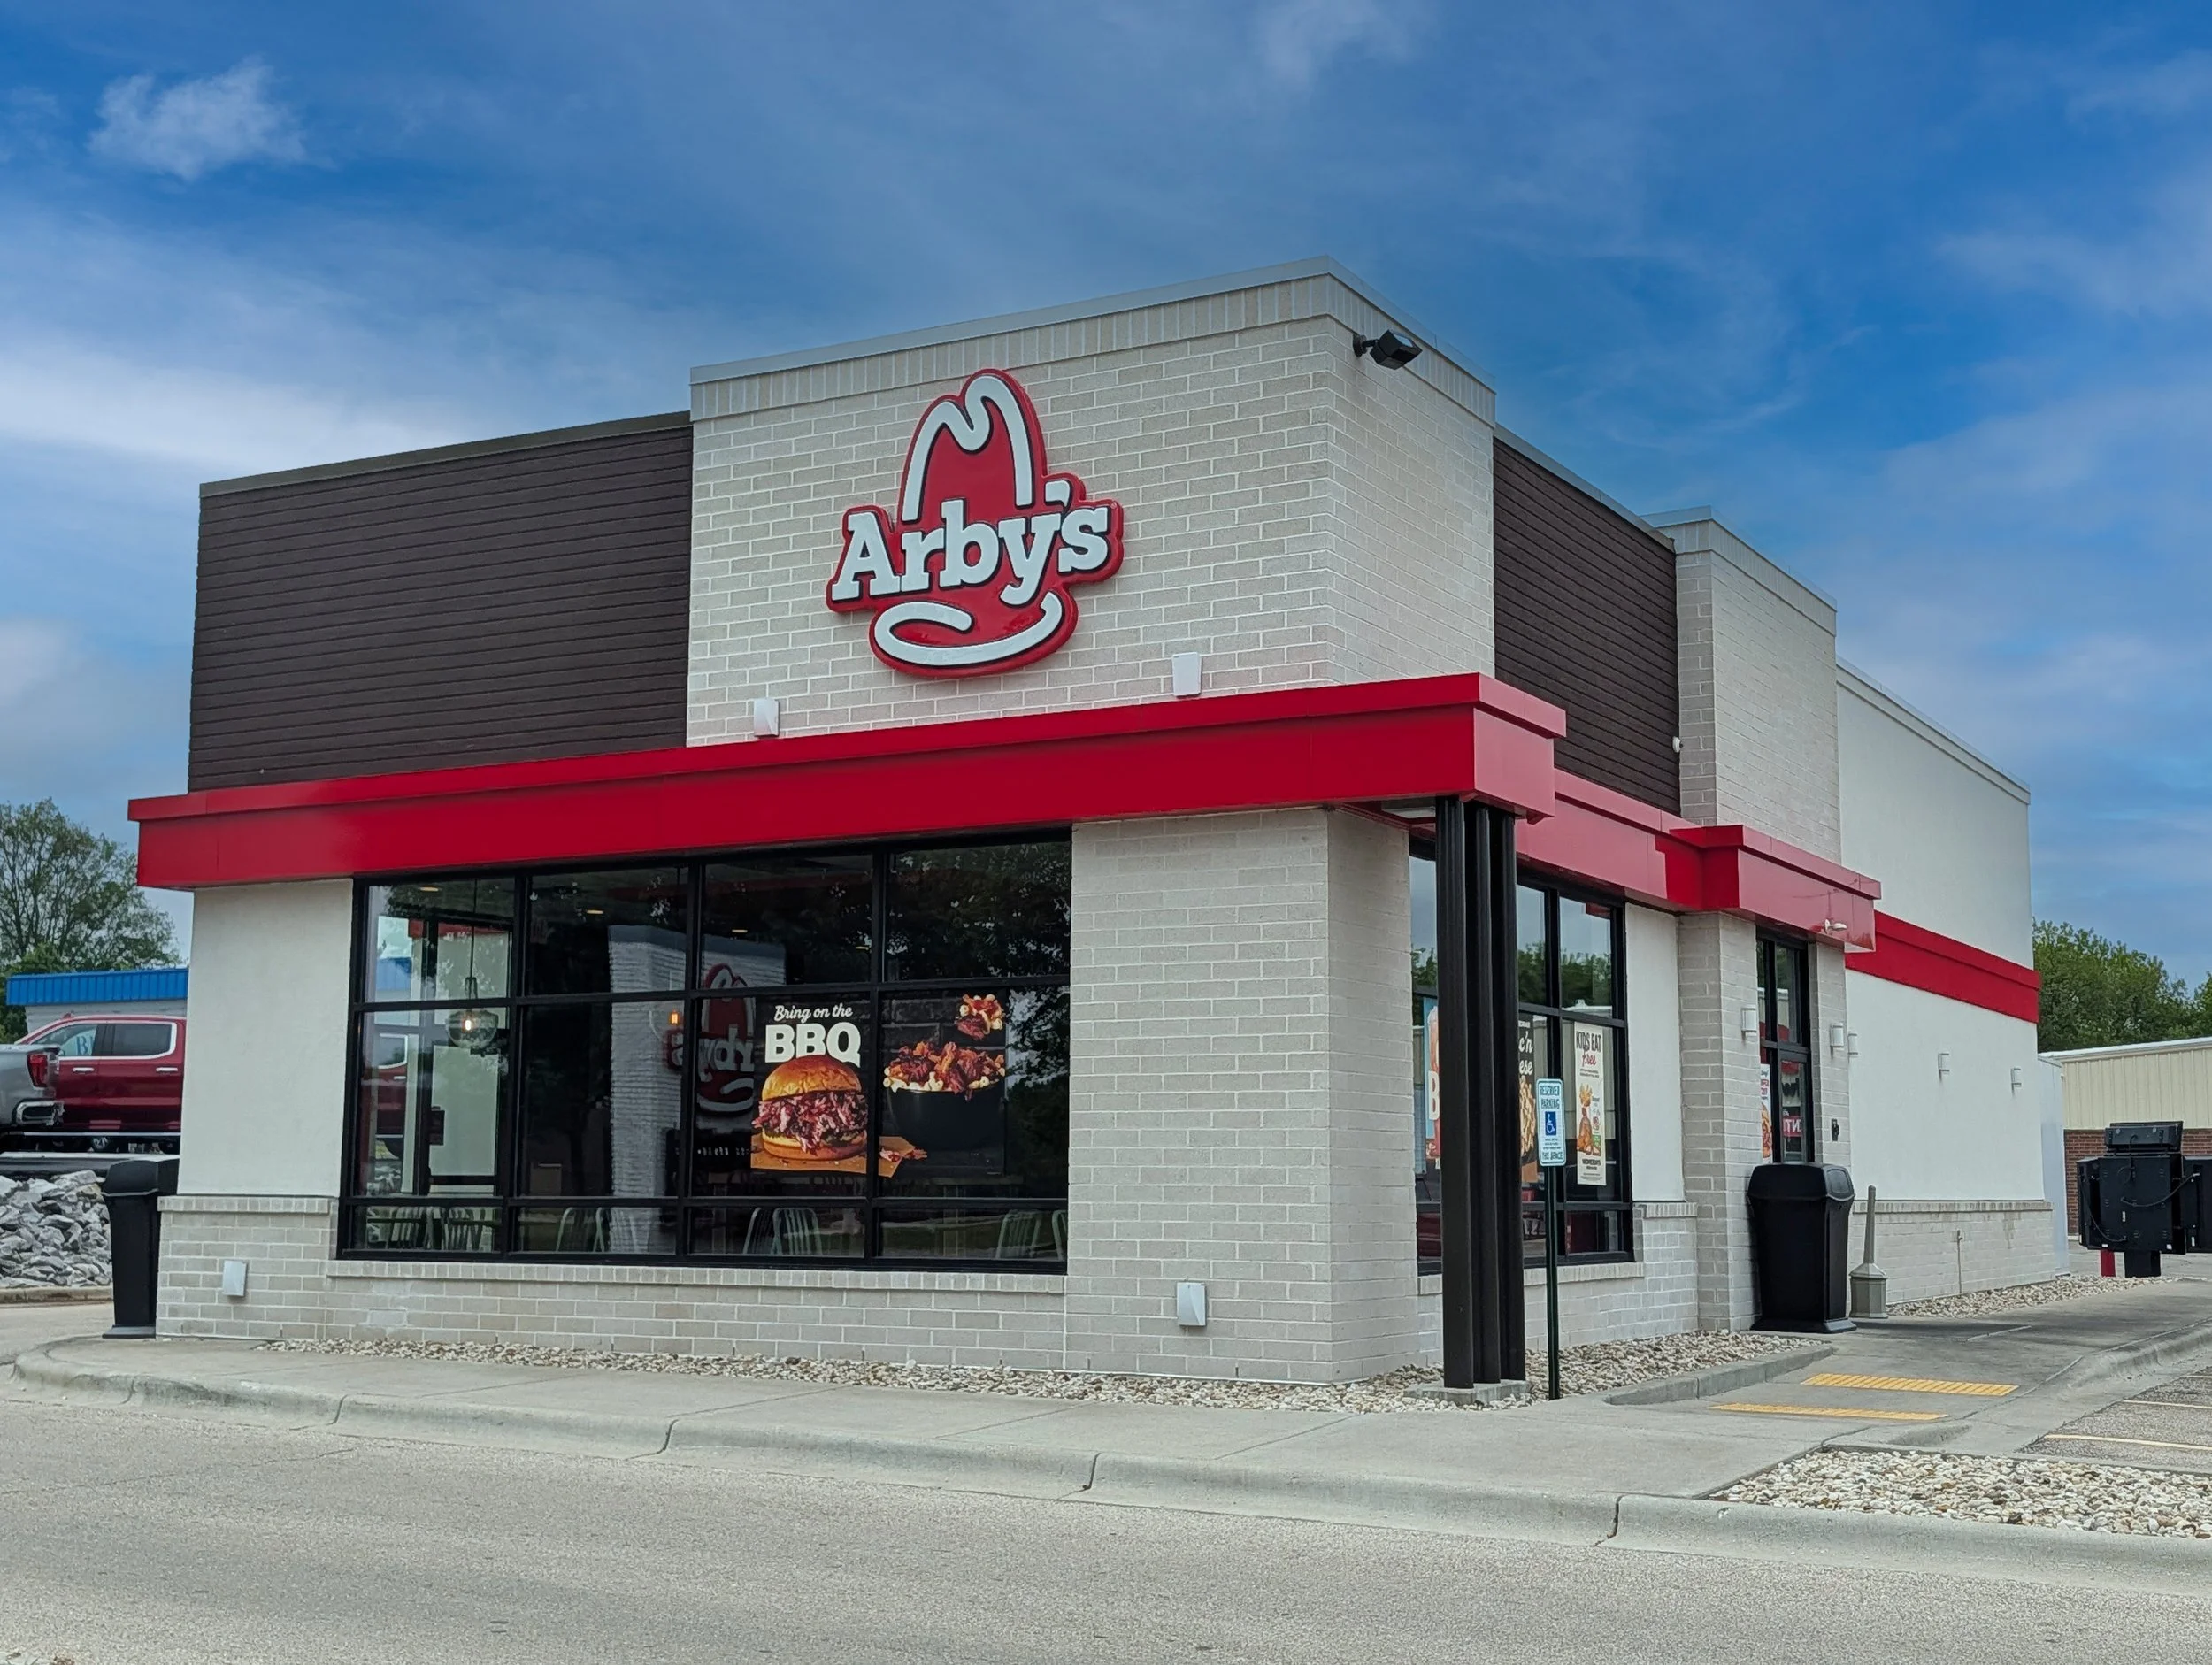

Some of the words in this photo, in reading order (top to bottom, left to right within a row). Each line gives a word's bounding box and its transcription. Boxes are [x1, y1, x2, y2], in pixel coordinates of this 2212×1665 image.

[831, 479, 1110, 606] Arby's
[774, 1005, 811, 1024] Bring
[813, 1008, 831, 1018] on
[832, 1002, 854, 1018] the
[764, 1022, 861, 1068] BBQ
[1591, 1032, 1601, 1053] EAT
